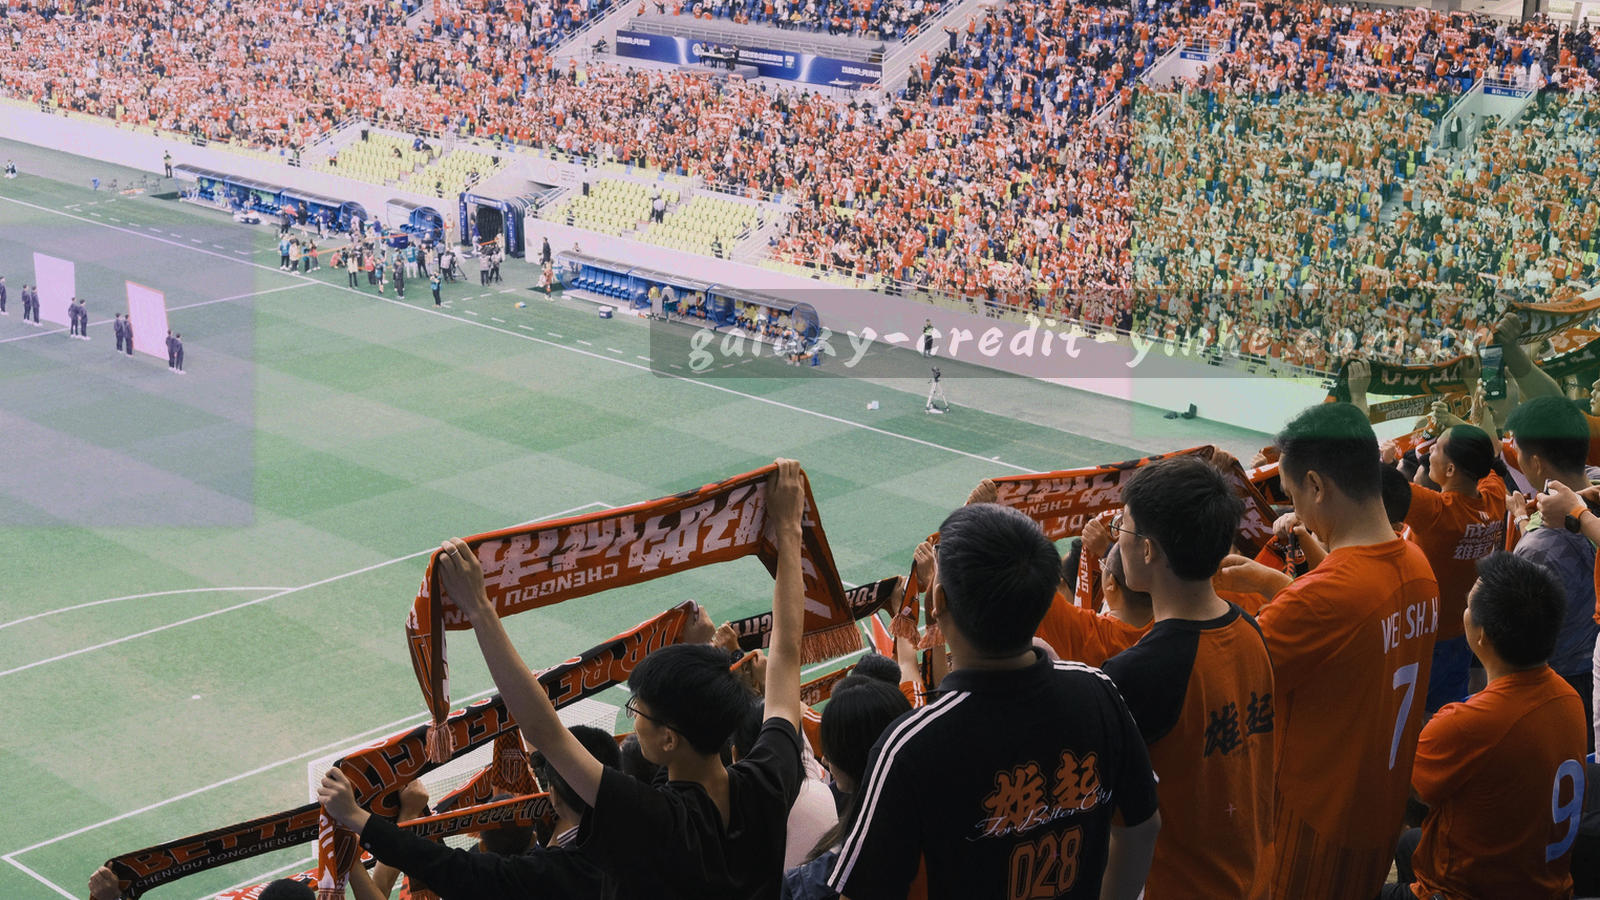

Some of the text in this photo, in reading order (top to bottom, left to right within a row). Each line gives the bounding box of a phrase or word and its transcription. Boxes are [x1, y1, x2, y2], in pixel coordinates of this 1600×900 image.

[505, 563, 619, 607] CHENGDU
[1203, 691, 1275, 758] 雄起
[1388, 661, 1419, 771] 7
[340, 737, 427, 804] CIT
[981, 747, 1103, 836] 雄起
[117, 809, 320, 878] BETTE
[1545, 758, 1586, 864] 9
[135, 857, 203, 888] CHENGDU
[206, 833, 298, 865] RONGCHENG
[1007, 824, 1084, 900] 028
